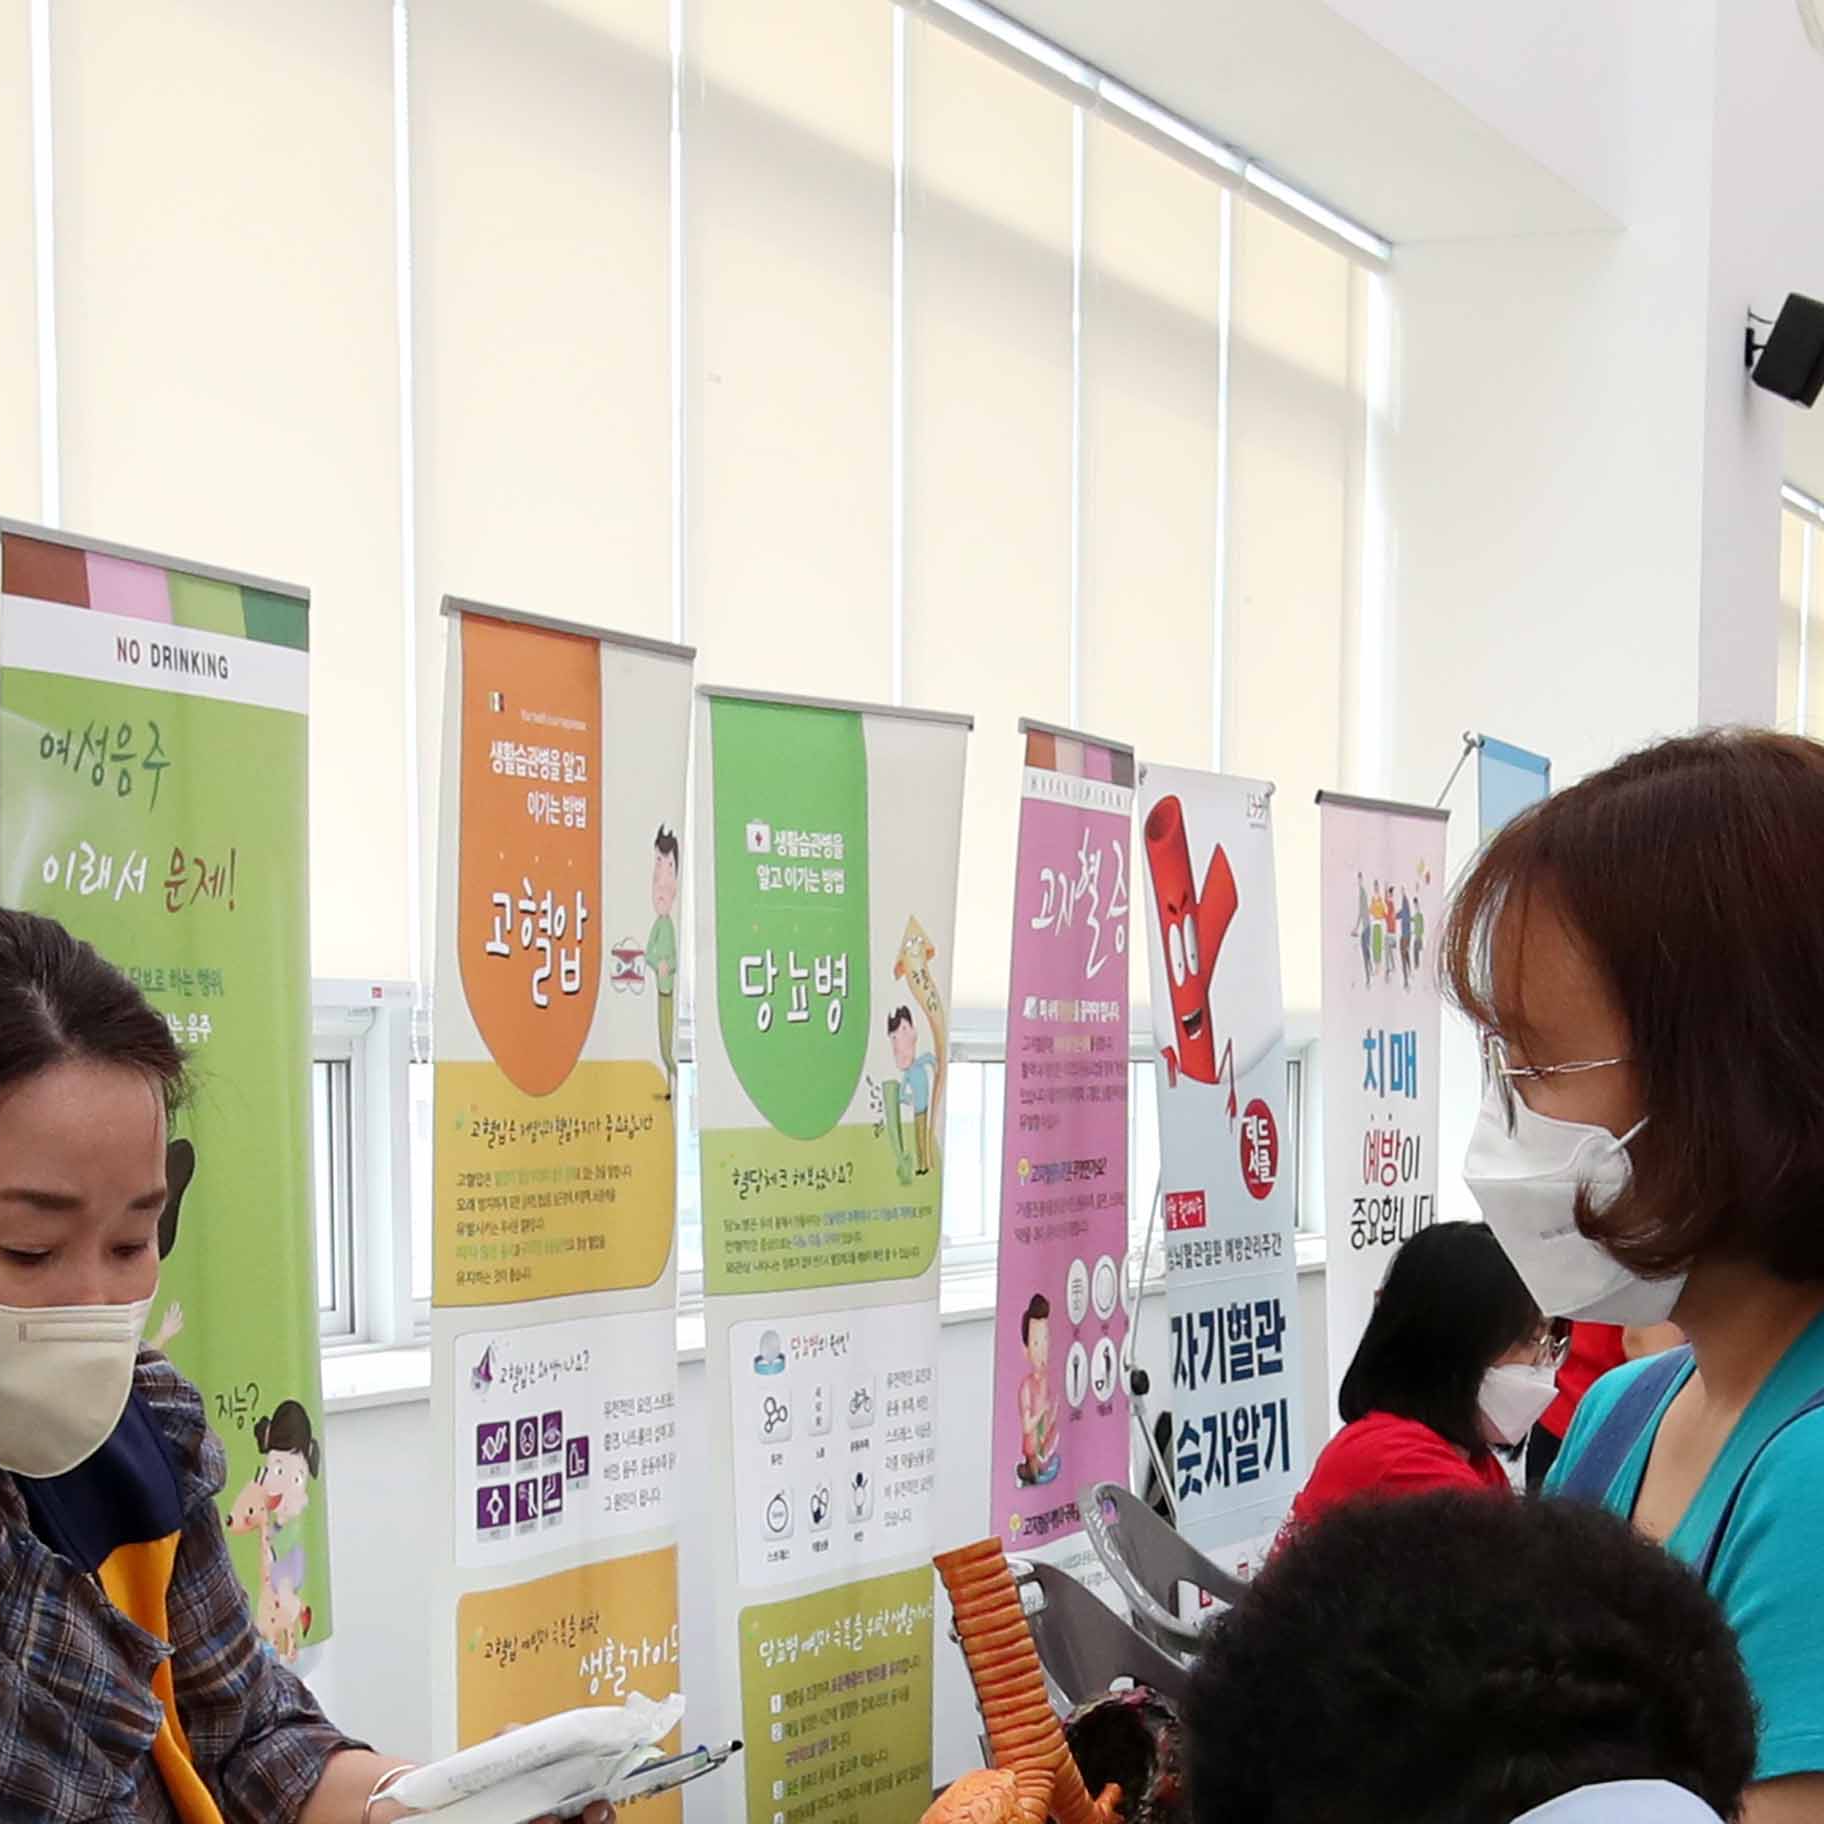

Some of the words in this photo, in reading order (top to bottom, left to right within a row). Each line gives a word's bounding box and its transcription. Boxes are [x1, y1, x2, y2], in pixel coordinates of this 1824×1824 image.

[116, 636, 140, 664] NO
[150, 643, 229, 680] DRINKING
[489, 738, 561, 783] 생활습관병을
[563, 751, 588, 784] 알고
[527, 790, 561, 825] 이기는
[563, 795, 588, 829] 방법
[774, 829, 844, 860] 생활습관병을
[42, 841, 149, 902] 이래서
[163, 847, 237, 914] 문제!
[757, 863, 784, 892] 알고
[784, 866, 820, 894] 이기는
[823, 868, 845, 895] 방법
[1031, 827, 1129, 980] 고지혈증
[485, 876, 588, 1008] 고혈압
[739, 948, 848, 1035] 당뇨병
[186, 1012, 212, 1044] 음주
[1363, 1028, 1417, 1099] 치매
[1363, 1129, 1421, 1187] 예방이
[1350, 1193, 1436, 1250] 중요합니다
[1171, 1298, 1285, 1391] 자기혈관
[215, 1382, 260, 1430] 지능?
[1177, 1398, 1290, 1502] 숫자알기
